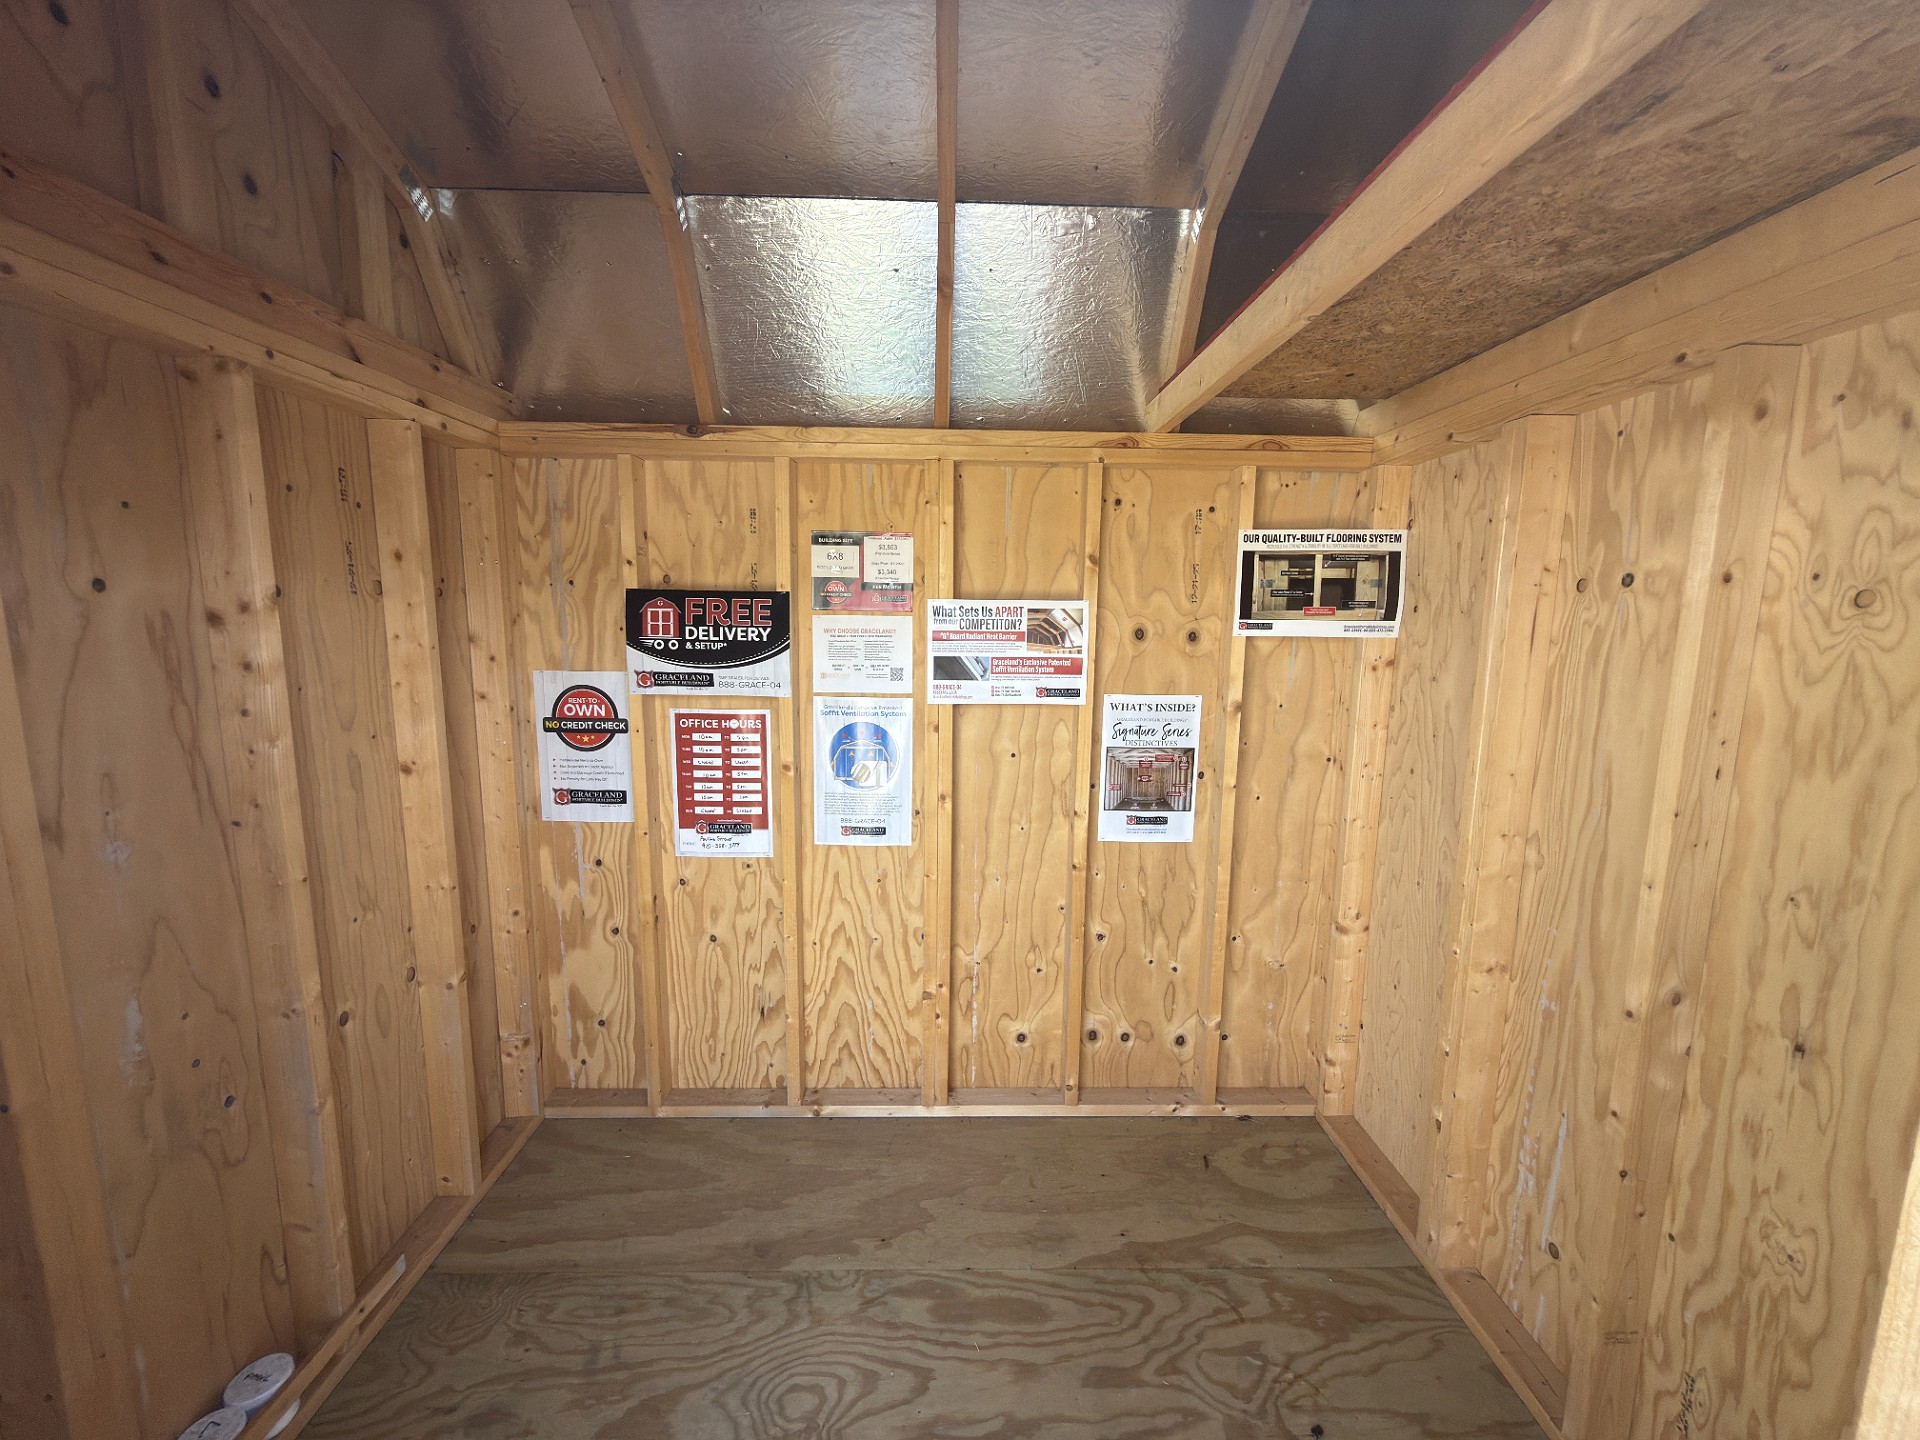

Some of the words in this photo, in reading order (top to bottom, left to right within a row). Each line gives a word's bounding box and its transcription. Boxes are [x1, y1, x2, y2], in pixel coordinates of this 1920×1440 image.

[1243, 534, 1260, 543] OUR
[1262, 534, 1324, 544] QUALITY-BUILT
[1326, 534, 1367, 543] FLOORING
[1369, 534, 1402, 543] SYSTEM
[685, 598, 772, 626] FREE
[932, 606, 957, 618] What
[958, 606, 979, 618] Sets
[982, 606, 993, 618] Us
[994, 606, 1024, 618] APART
[685, 626, 772, 642] DELIVERY
[950, 632, 965, 640] Board
[686, 642, 692, 650] &
[992, 658, 1022, 666] Graceland's
[1024, 658, 1048, 666] Exclusive
[1036, 666, 1054, 674] System
[564, 704, 606, 716] OWN
[1110, 702, 1153, 712] WHAT'S
[1155, 704, 1196, 712] INSIDE?
[545, 720, 560, 728] NO
[561, 721, 593, 730] CREDIT
[594, 722, 626, 730] CHECK
[680, 718, 719, 728] OFFICE
[722, 719, 762, 729] HOURS
[1112, 722, 1158, 741] Signature
[1162, 722, 1193, 740] Series
